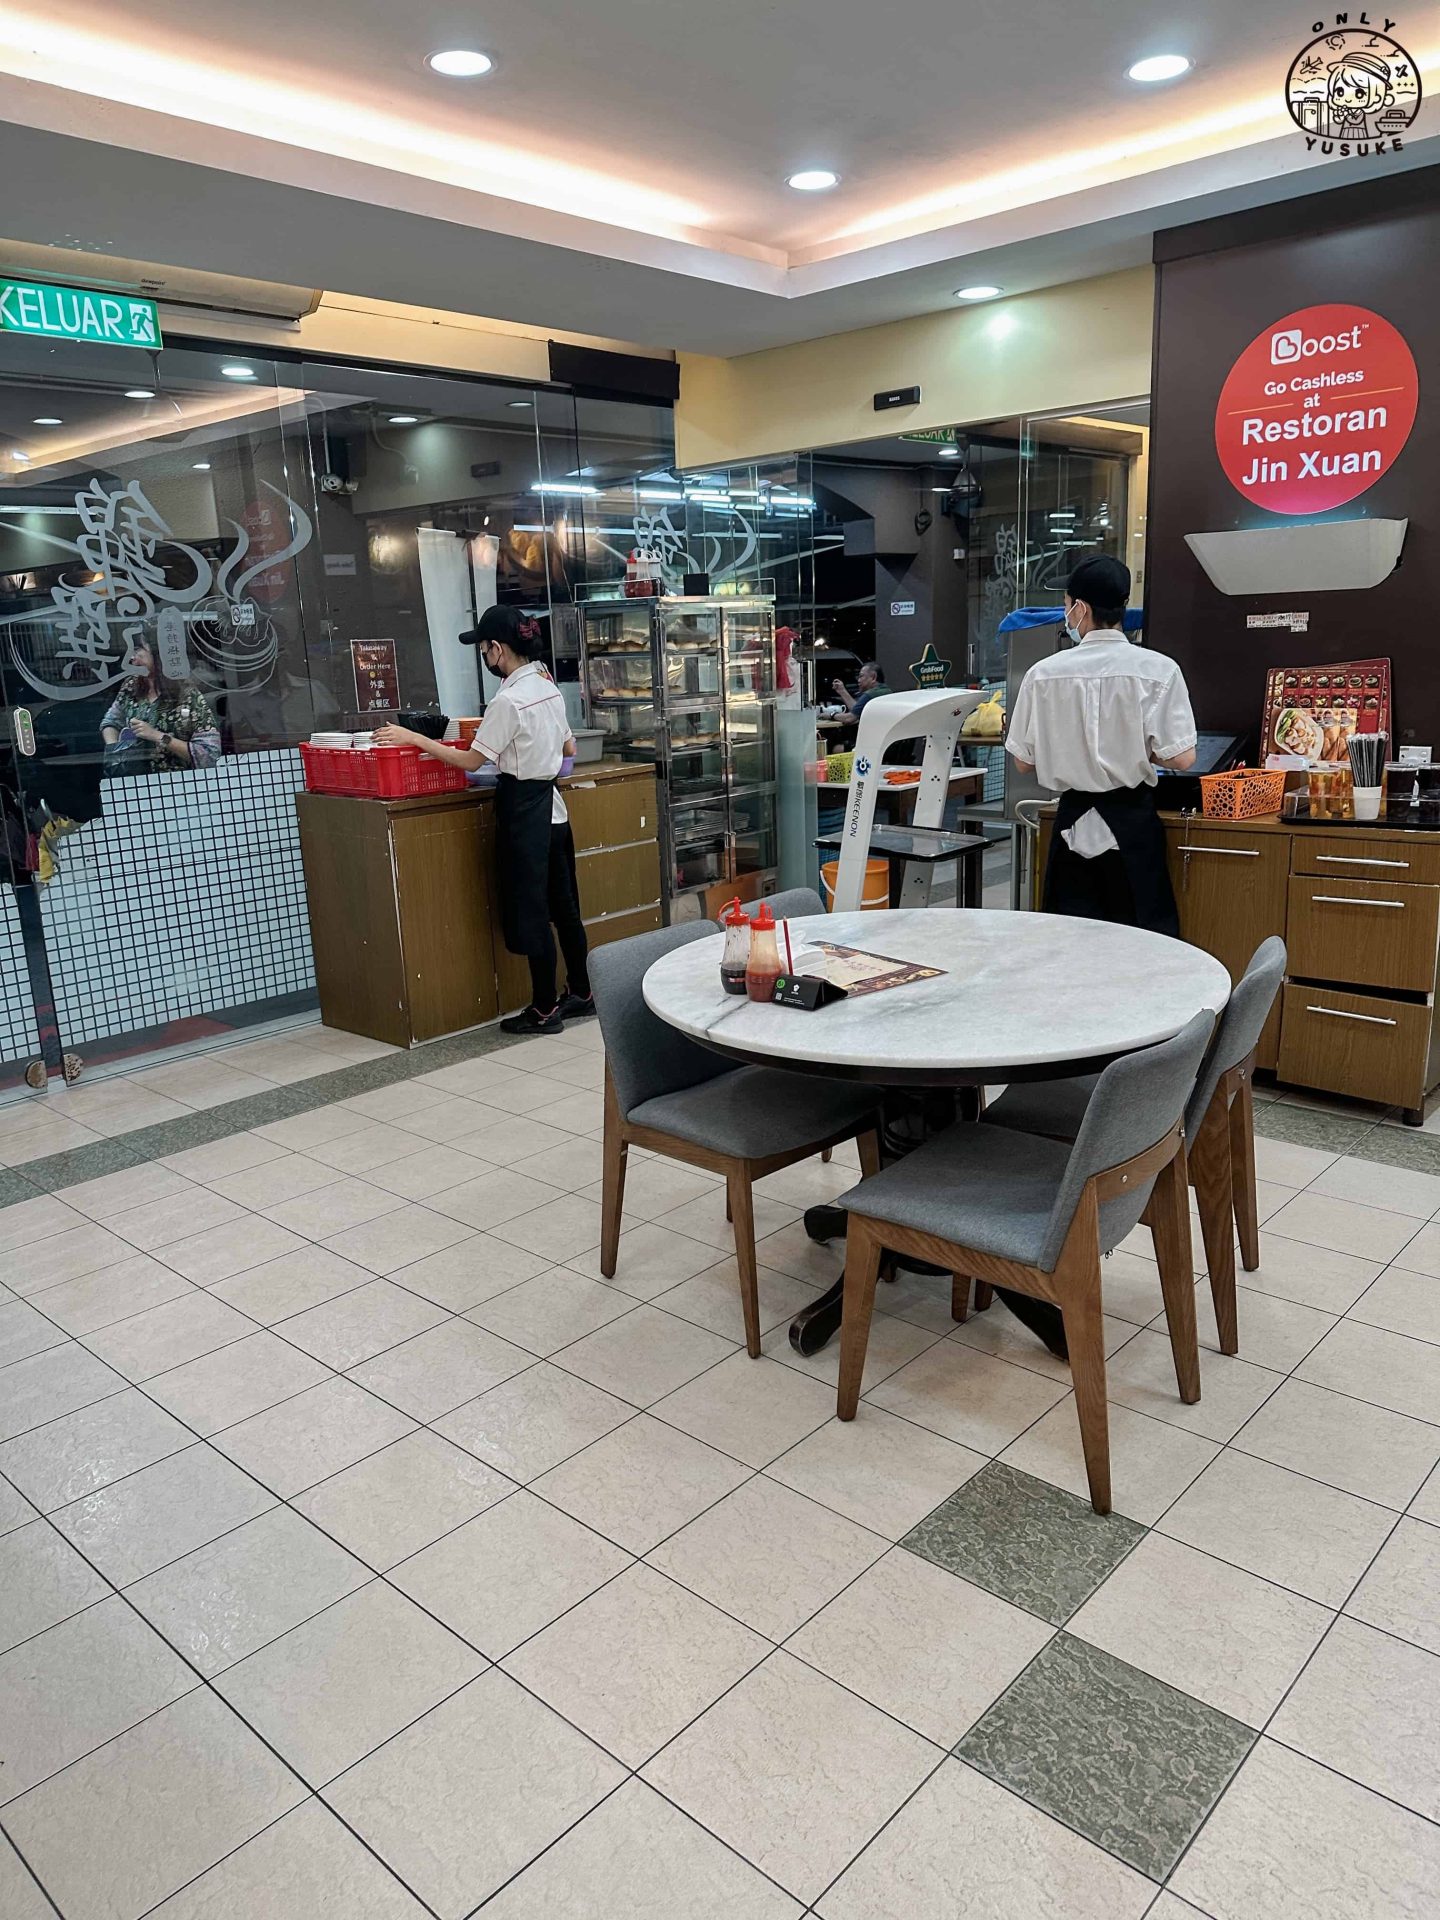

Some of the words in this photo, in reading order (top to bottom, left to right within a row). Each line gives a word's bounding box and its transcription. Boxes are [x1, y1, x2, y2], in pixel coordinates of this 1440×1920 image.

[0, 285, 126, 339] KELUAR
[1264, 381, 1287, 396] Go
[1290, 370, 1365, 392] Cashless
[1303, 393, 1321, 409] at
[1242, 406, 1387, 446] Restoran
[1242, 457, 1288, 486] Jin
[1297, 449, 1382, 480] Xuan
[360, 663, 376, 671] Order
[920, 664, 944, 674] GrabFood
[849, 797, 862, 838] KEENON
